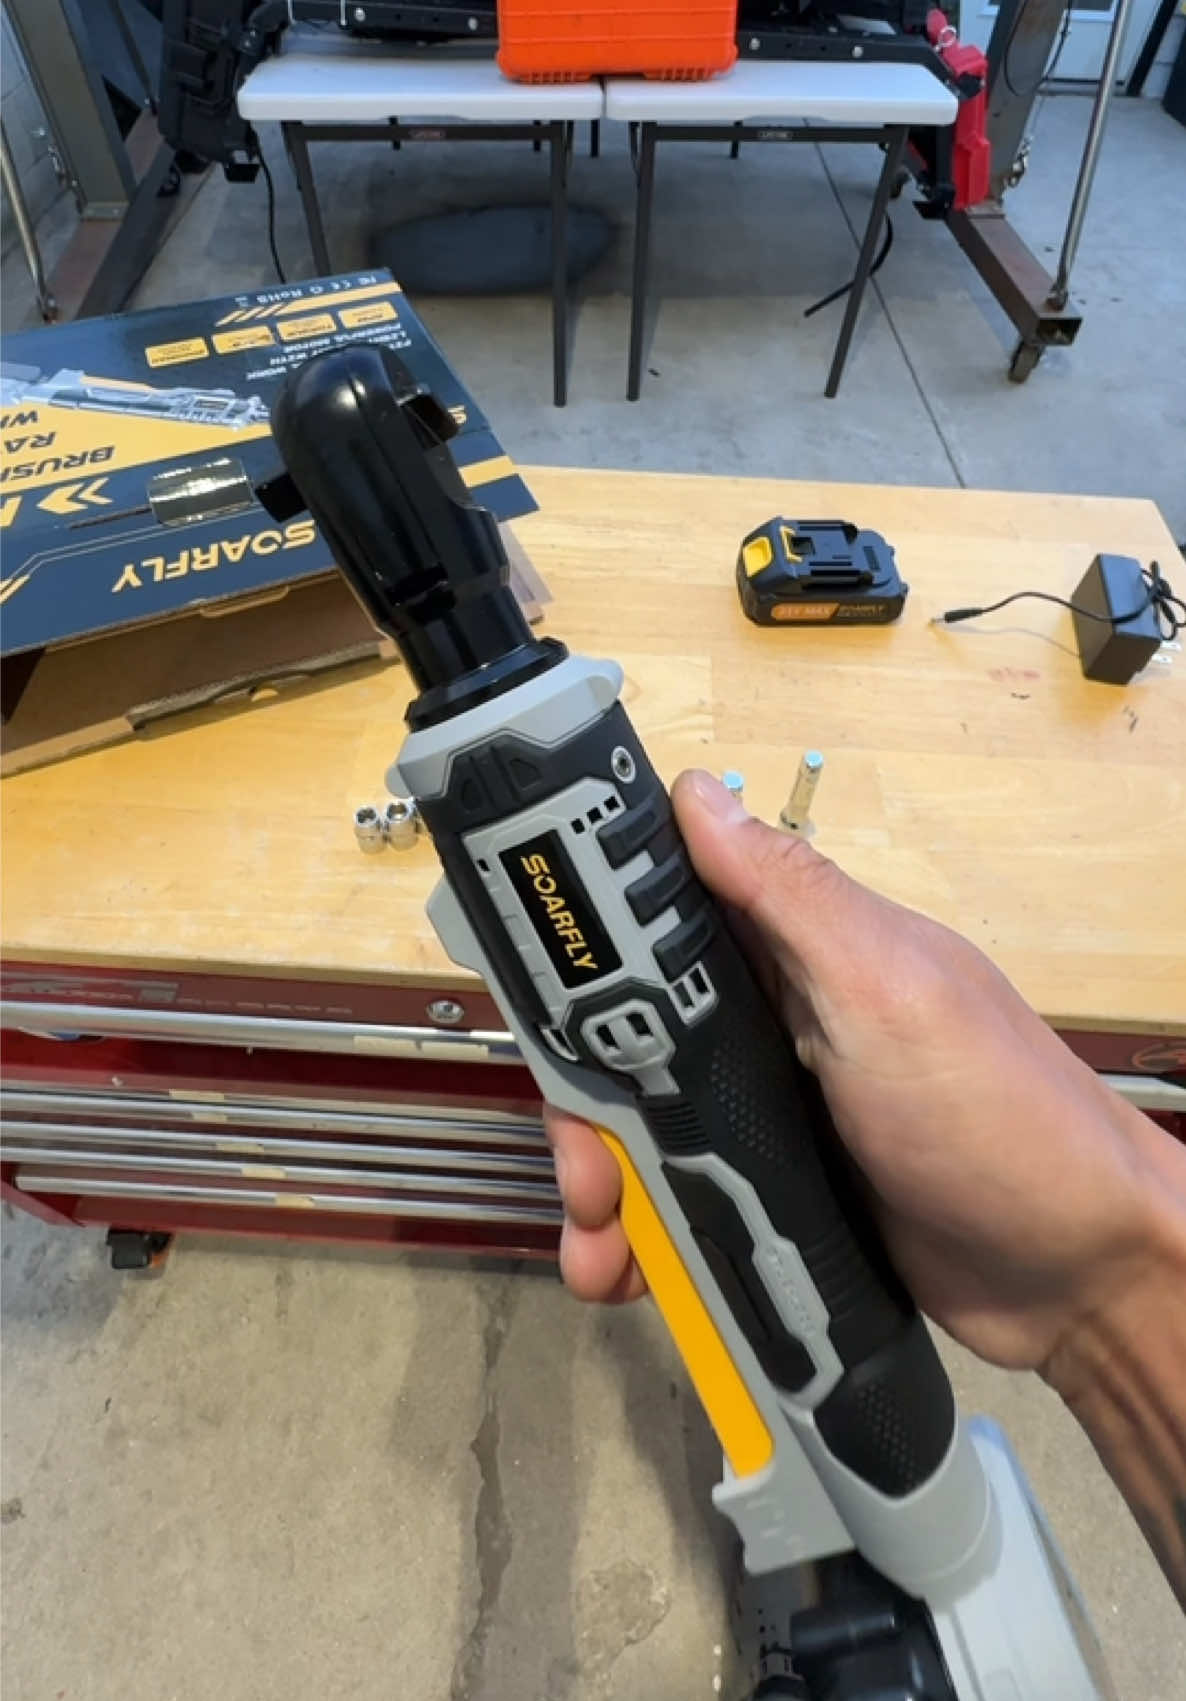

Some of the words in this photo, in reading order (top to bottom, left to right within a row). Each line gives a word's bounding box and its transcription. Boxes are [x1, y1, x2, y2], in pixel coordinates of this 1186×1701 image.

[257, 288, 303, 304] RoHS
[111, 519, 317, 593] SOARFLY
[520, 854, 598, 969] SOARFLY
